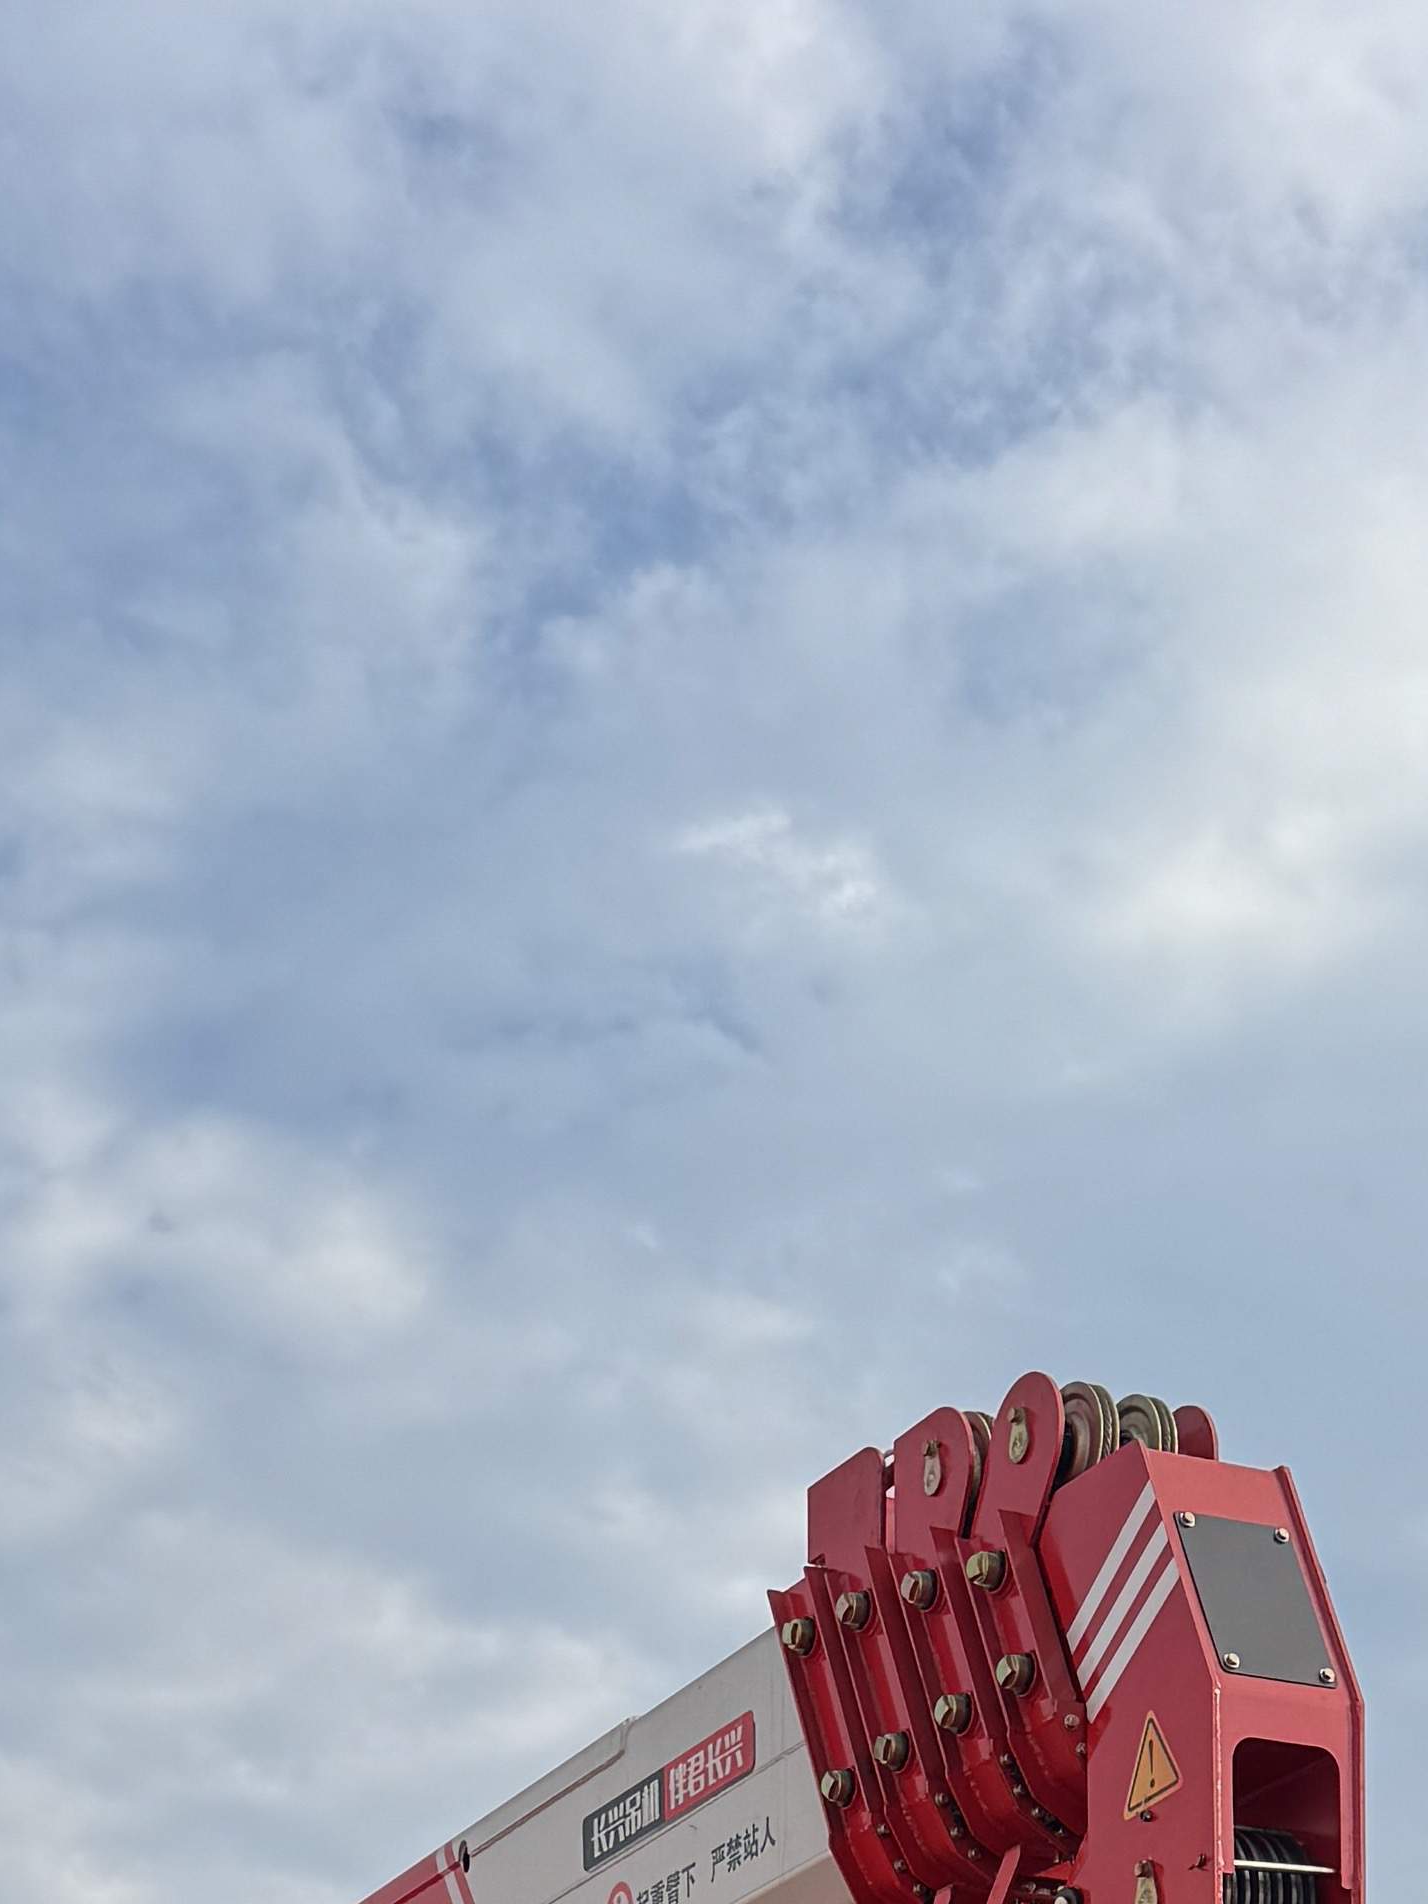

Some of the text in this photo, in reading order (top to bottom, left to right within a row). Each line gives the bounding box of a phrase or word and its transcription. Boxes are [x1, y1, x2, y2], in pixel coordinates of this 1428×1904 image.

[591, 1779, 661, 1859] 长兴吊机
[711, 1816, 775, 1883] 严禁站人
